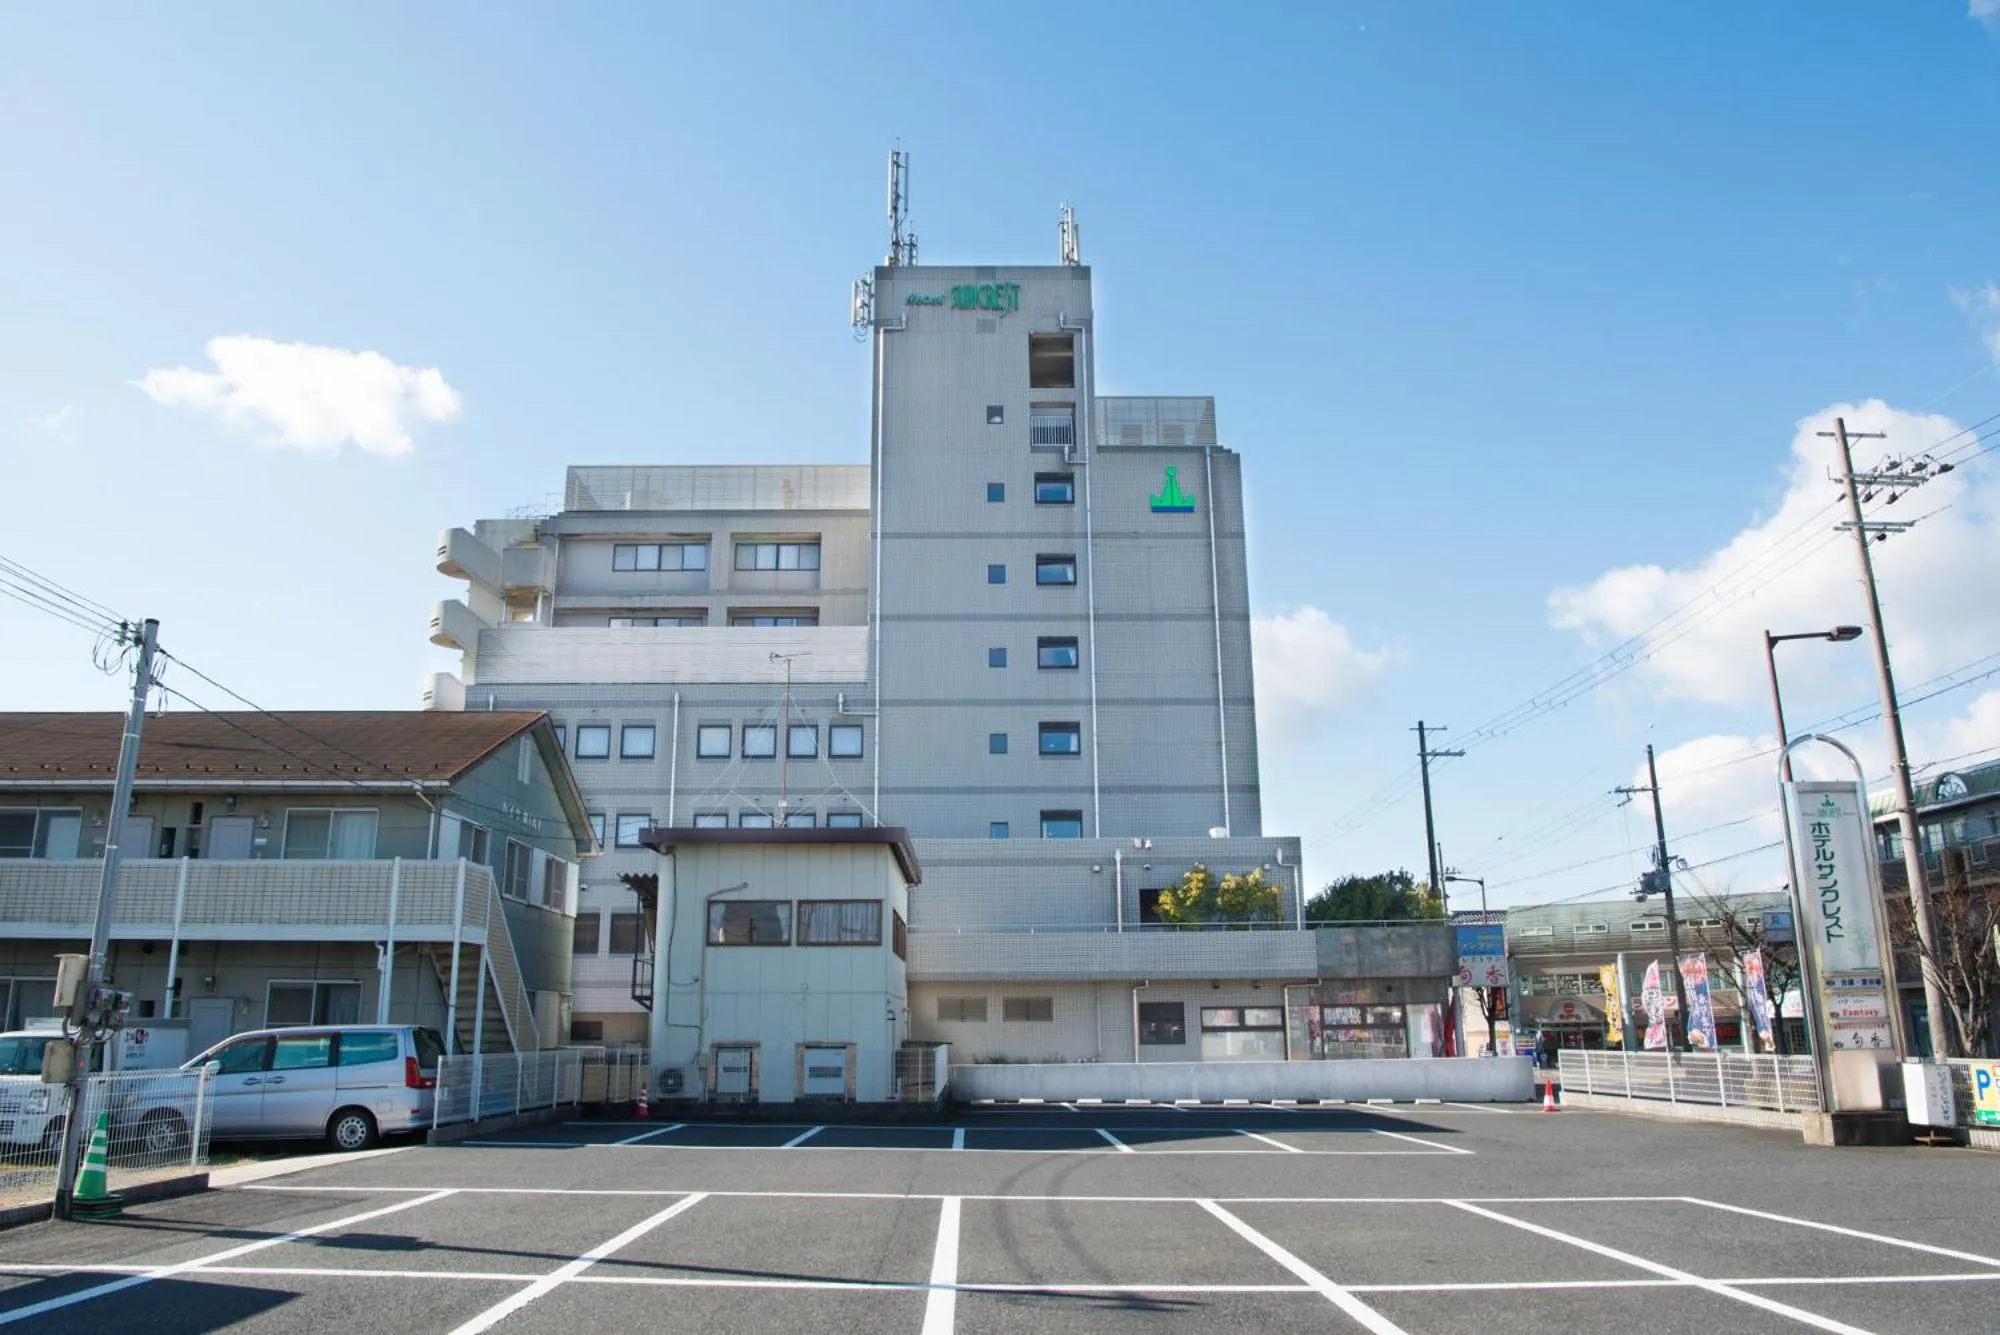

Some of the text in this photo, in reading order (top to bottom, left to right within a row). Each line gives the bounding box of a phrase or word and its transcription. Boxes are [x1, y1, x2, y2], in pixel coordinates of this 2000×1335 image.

[1810, 820, 1845, 944] ホテルサンクレスト
[1842, 1008, 1879, 1017] Fantasy
[1976, 1068, 1991, 1101] P
